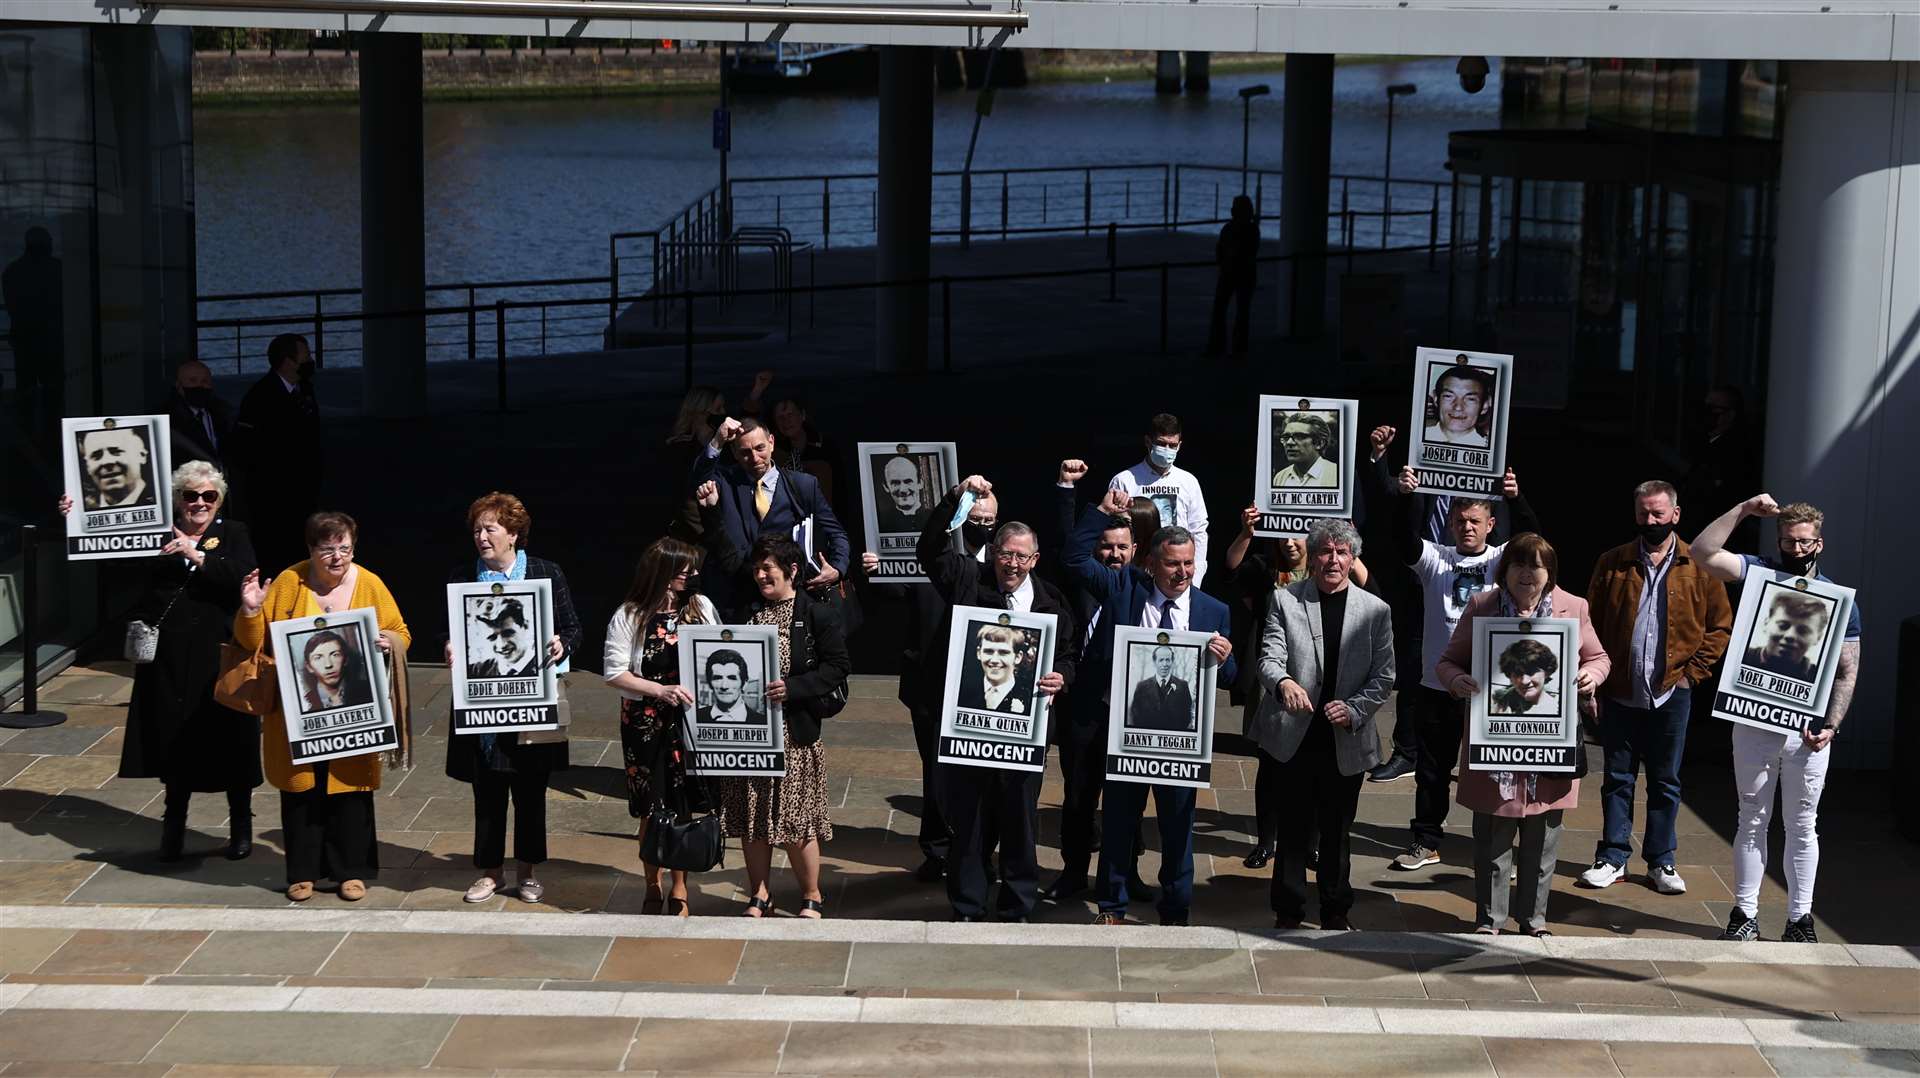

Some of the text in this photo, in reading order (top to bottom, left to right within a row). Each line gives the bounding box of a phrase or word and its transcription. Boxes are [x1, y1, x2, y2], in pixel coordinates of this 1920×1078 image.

[1422, 446, 1489, 466] JOSEPH CORR
[1417, 471, 1495, 492] INNOCENT
[1141, 486, 1180, 495] INNOCENT
[1271, 493, 1339, 505] PAT MC CARTHY
[87, 510, 157, 527] JOHN MC KERR
[1263, 515, 1320, 532] INNOC
[78, 534, 164, 552] INNOCENT
[878, 561, 926, 575] INNOC
[468, 681, 538, 697] EDDIE DOHERTY
[1737, 668, 1812, 700] NOEL PHILIPS
[303, 707, 376, 731] JOHN LAVERTY
[464, 707, 549, 726] INNOCENT
[1724, 696, 1814, 731] INNOCENT
[955, 712, 1030, 733] FRANK QUINN
[1488, 722, 1561, 734] JOAN CONNOLLY
[301, 729, 386, 756] INNOCENT
[696, 728, 768, 741] JOSEPH MURPHY
[1123, 733, 1198, 750] DANNY TEGGART
[950, 739, 1035, 762] INNOCENT
[1480, 747, 1567, 763] INNOCENT
[695, 753, 777, 768] INNOCENT
[1116, 757, 1202, 779] INNOCENT
